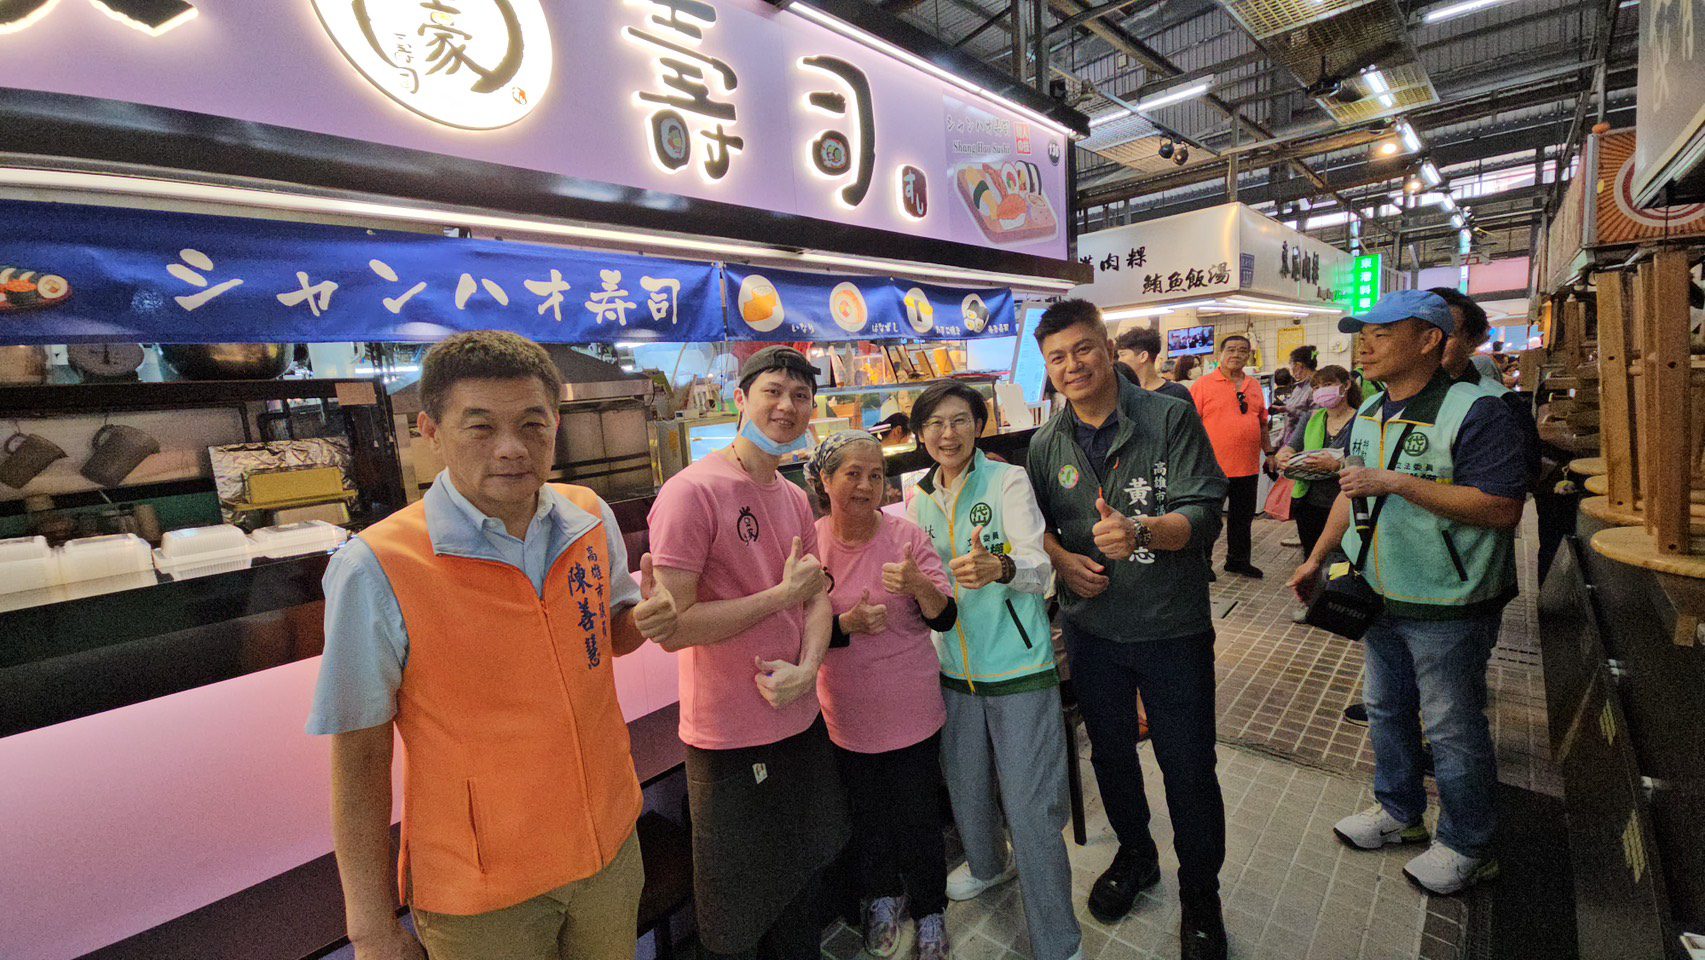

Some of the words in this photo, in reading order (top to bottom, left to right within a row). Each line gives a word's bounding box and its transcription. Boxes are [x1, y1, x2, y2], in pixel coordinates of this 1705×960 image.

[953, 140, 976, 154] Shang
[992, 144, 1011, 154] Sushi
[904, 169, 924, 215] すし
[166, 248, 681, 326] シャンハオ寿司
[1142, 261, 1232, 295] 鮪魚飯湯
[791, 321, 816, 334] いなり
